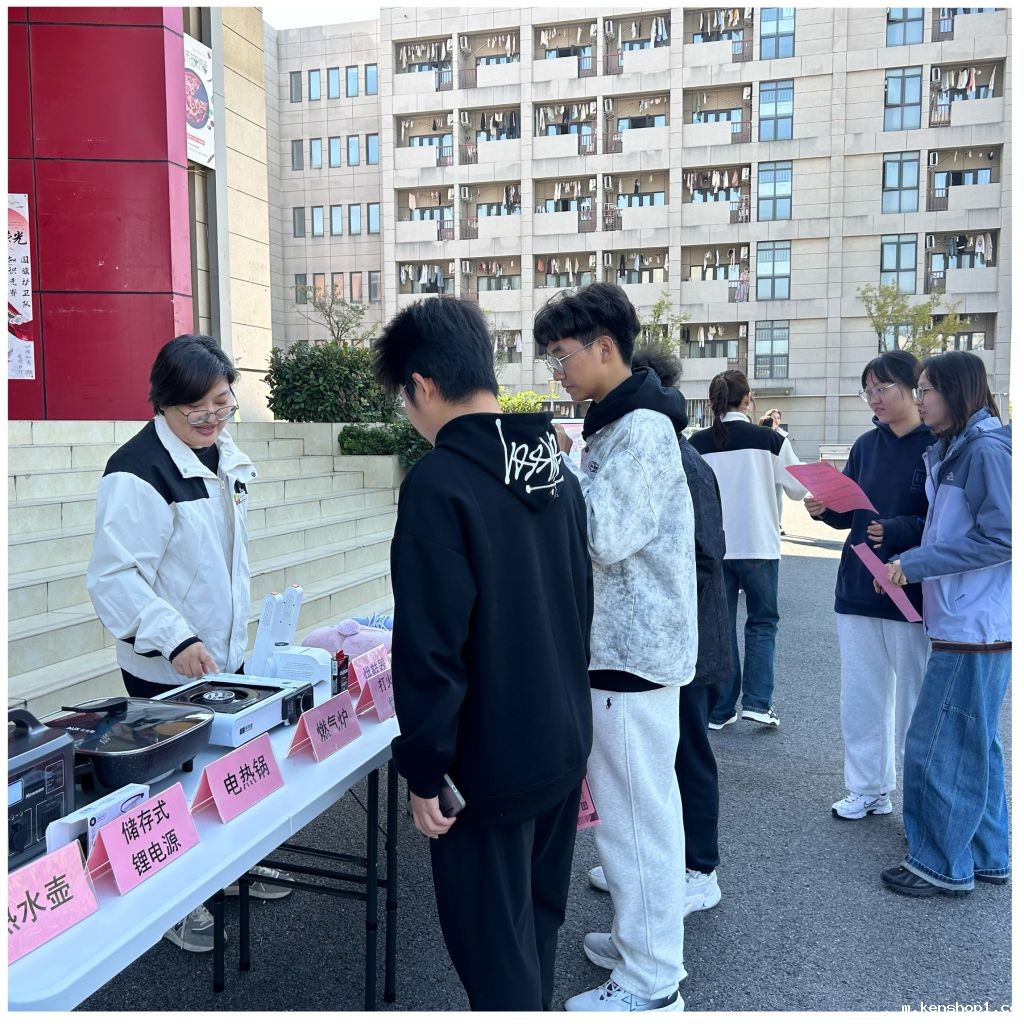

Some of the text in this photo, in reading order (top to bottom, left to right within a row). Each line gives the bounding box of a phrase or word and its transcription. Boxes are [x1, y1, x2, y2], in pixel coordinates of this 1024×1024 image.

[315, 707, 349, 742] 燃气炉
[222, 755, 271, 798] 电热锅
[121, 799, 171, 845] 储存式
[131, 828, 182, 878] 锂电源
